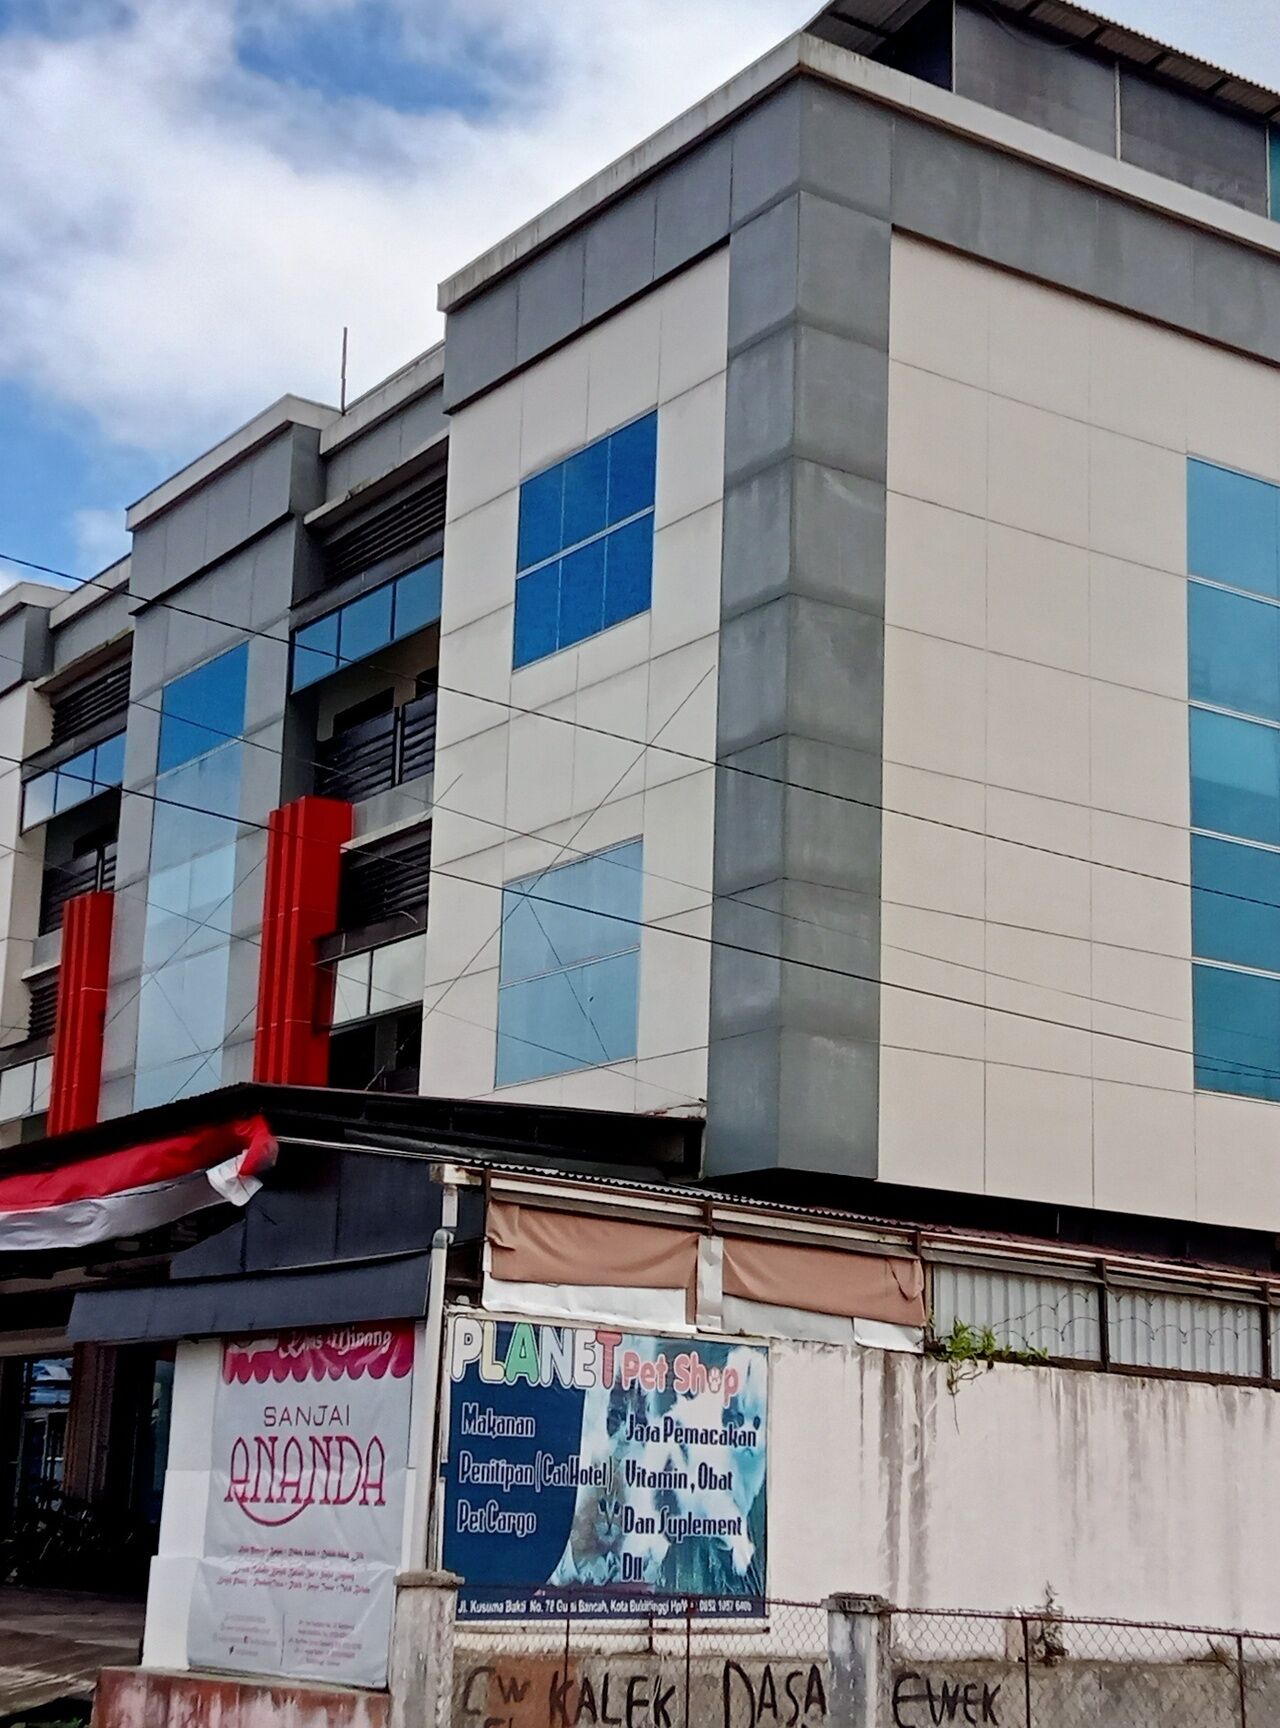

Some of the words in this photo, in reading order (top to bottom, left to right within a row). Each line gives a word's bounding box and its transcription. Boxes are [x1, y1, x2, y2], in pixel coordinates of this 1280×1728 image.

[451, 1315, 621, 1391] PLANET
[622, 1351, 668, 1392] Pet
[263, 1404, 350, 1428] SANJAI
[461, 1402, 536, 1438] Makanan
[663, 1416, 757, 1448] Pemacakan
[223, 1435, 387, 1520] ANANDA
[698, 1462, 733, 1491] Obat
[623, 1505, 655, 1534] Dan
[658, 1506, 742, 1543] Suplement
[529, 1599, 544, 1613] No.
[610, 1599, 628, 1614] Kota
[722, 1658, 828, 1728] DASA
